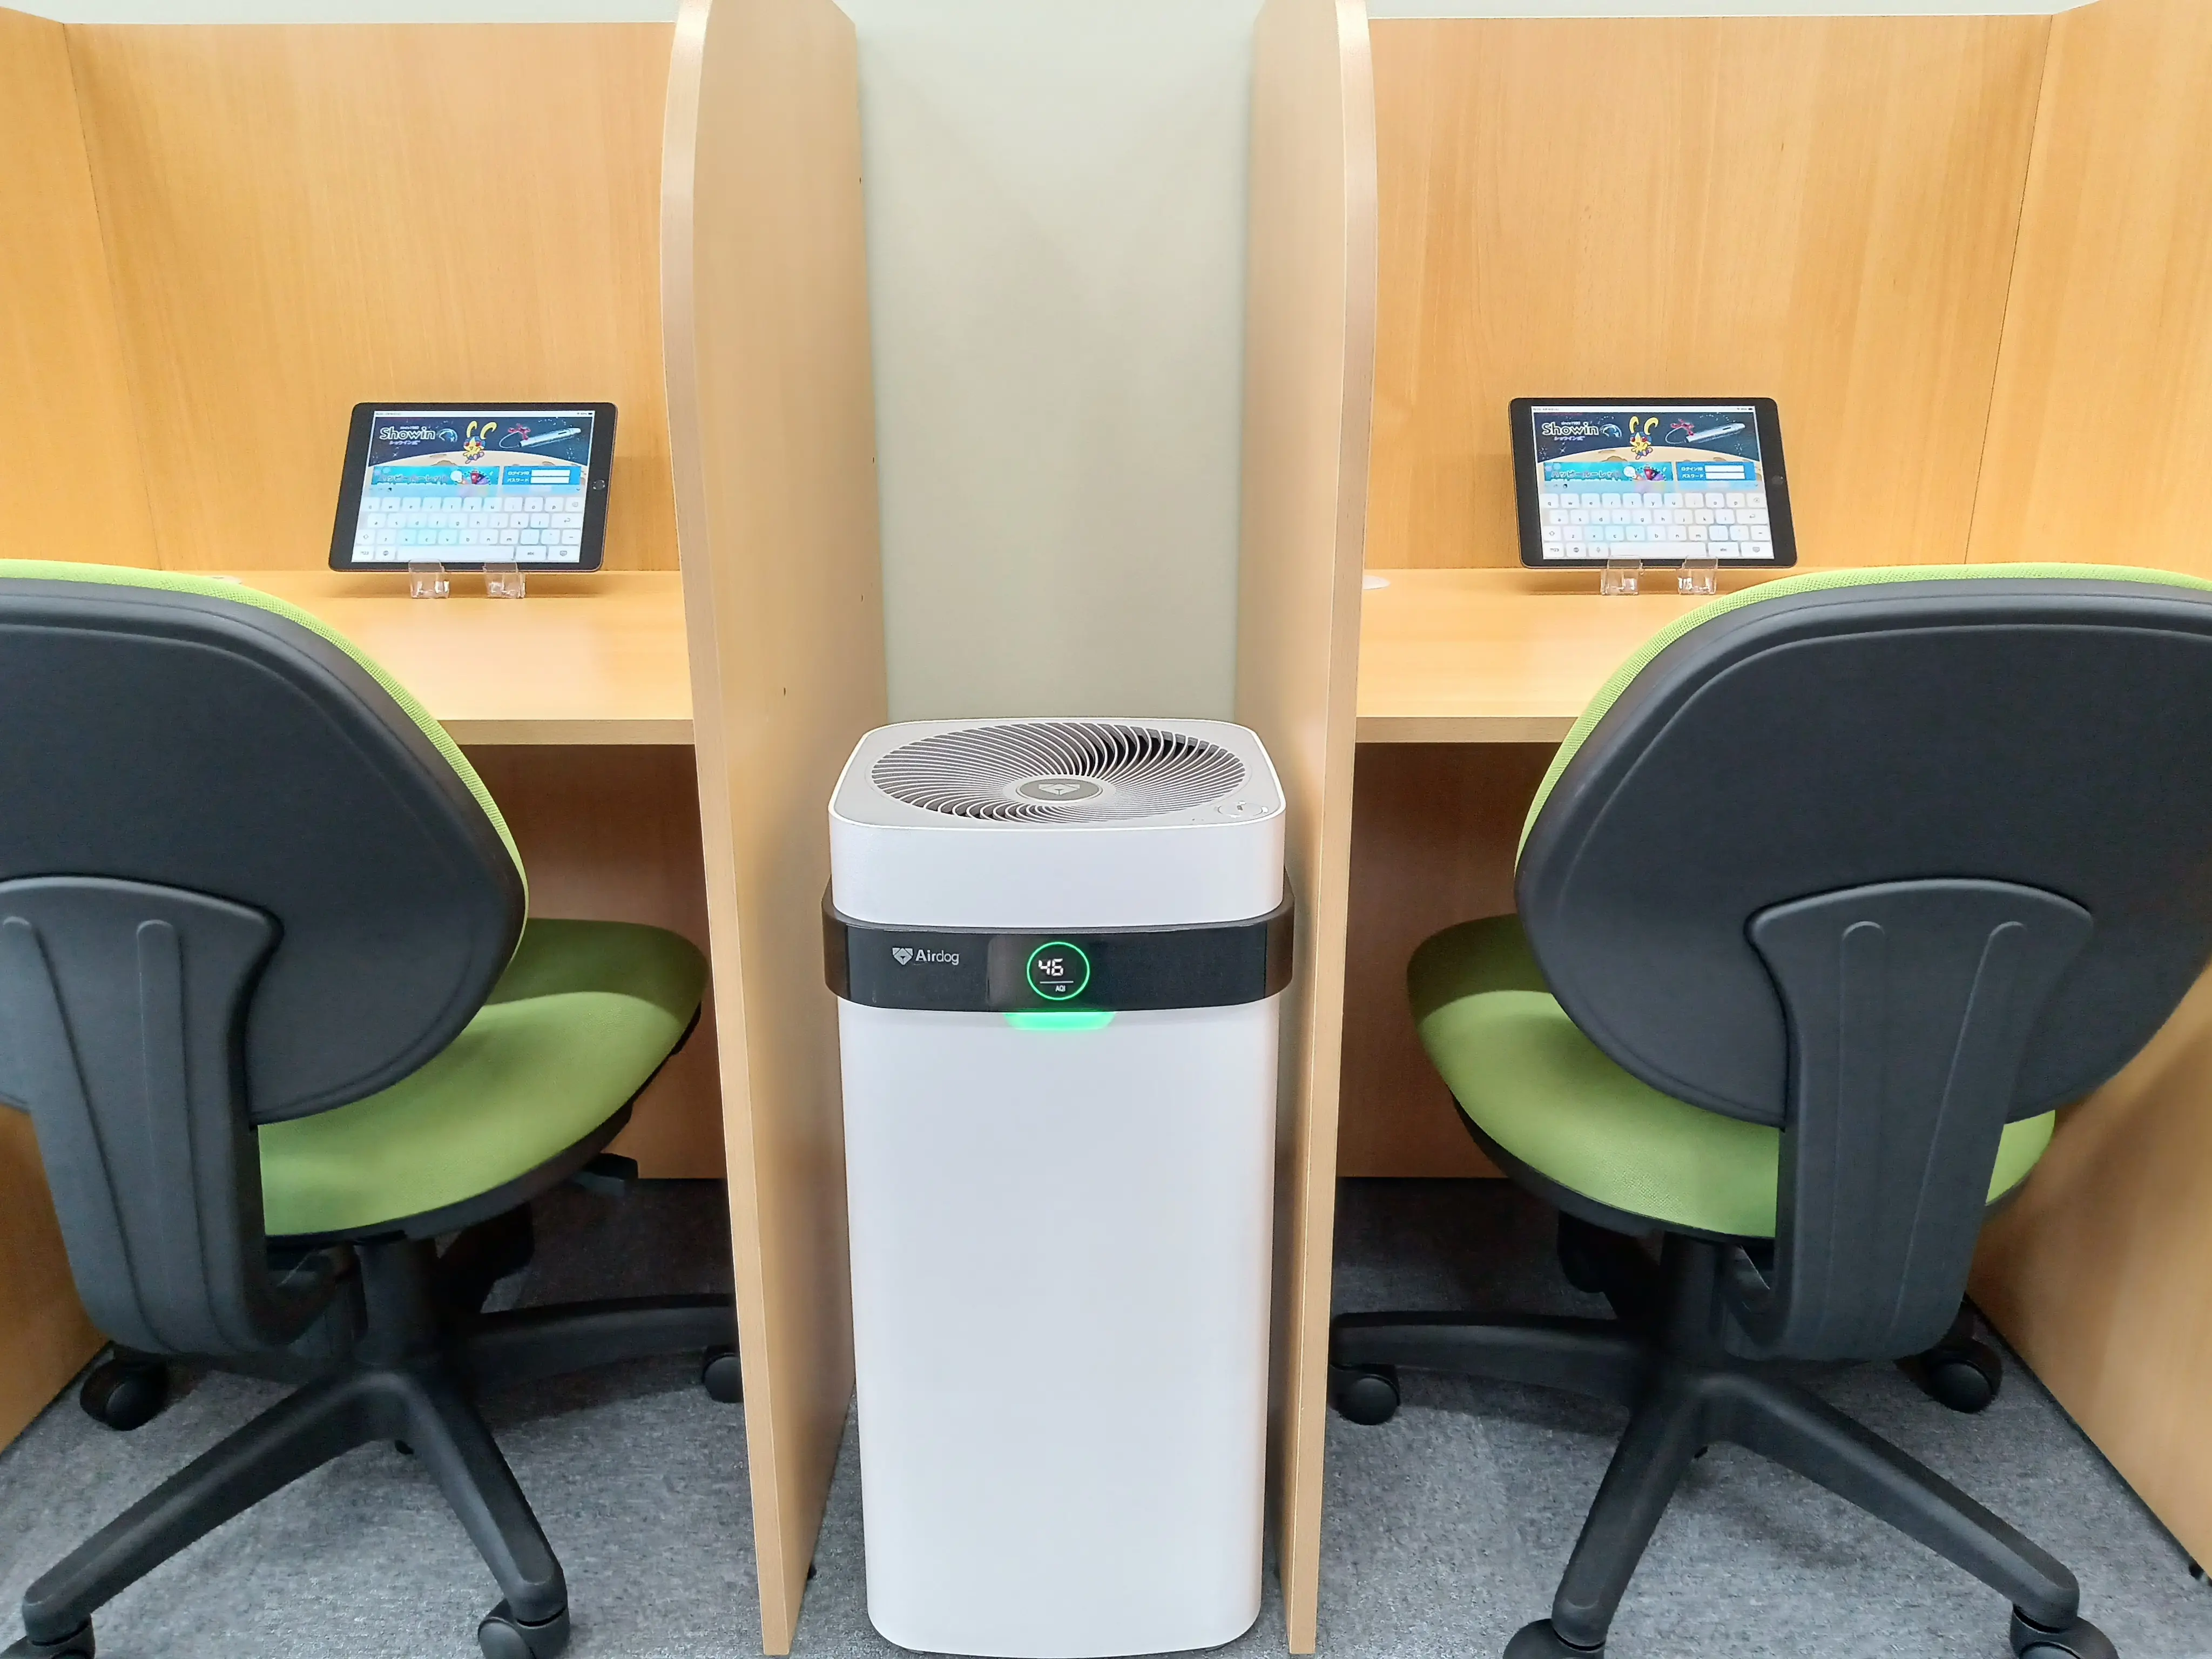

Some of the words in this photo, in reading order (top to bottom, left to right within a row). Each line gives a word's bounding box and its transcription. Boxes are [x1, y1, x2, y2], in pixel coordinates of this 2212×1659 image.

[380, 427, 435, 440] Showin
[1542, 421, 1599, 436] Showin
[915, 949, 959, 966] Airdog
[1038, 958, 1064, 976] 46
